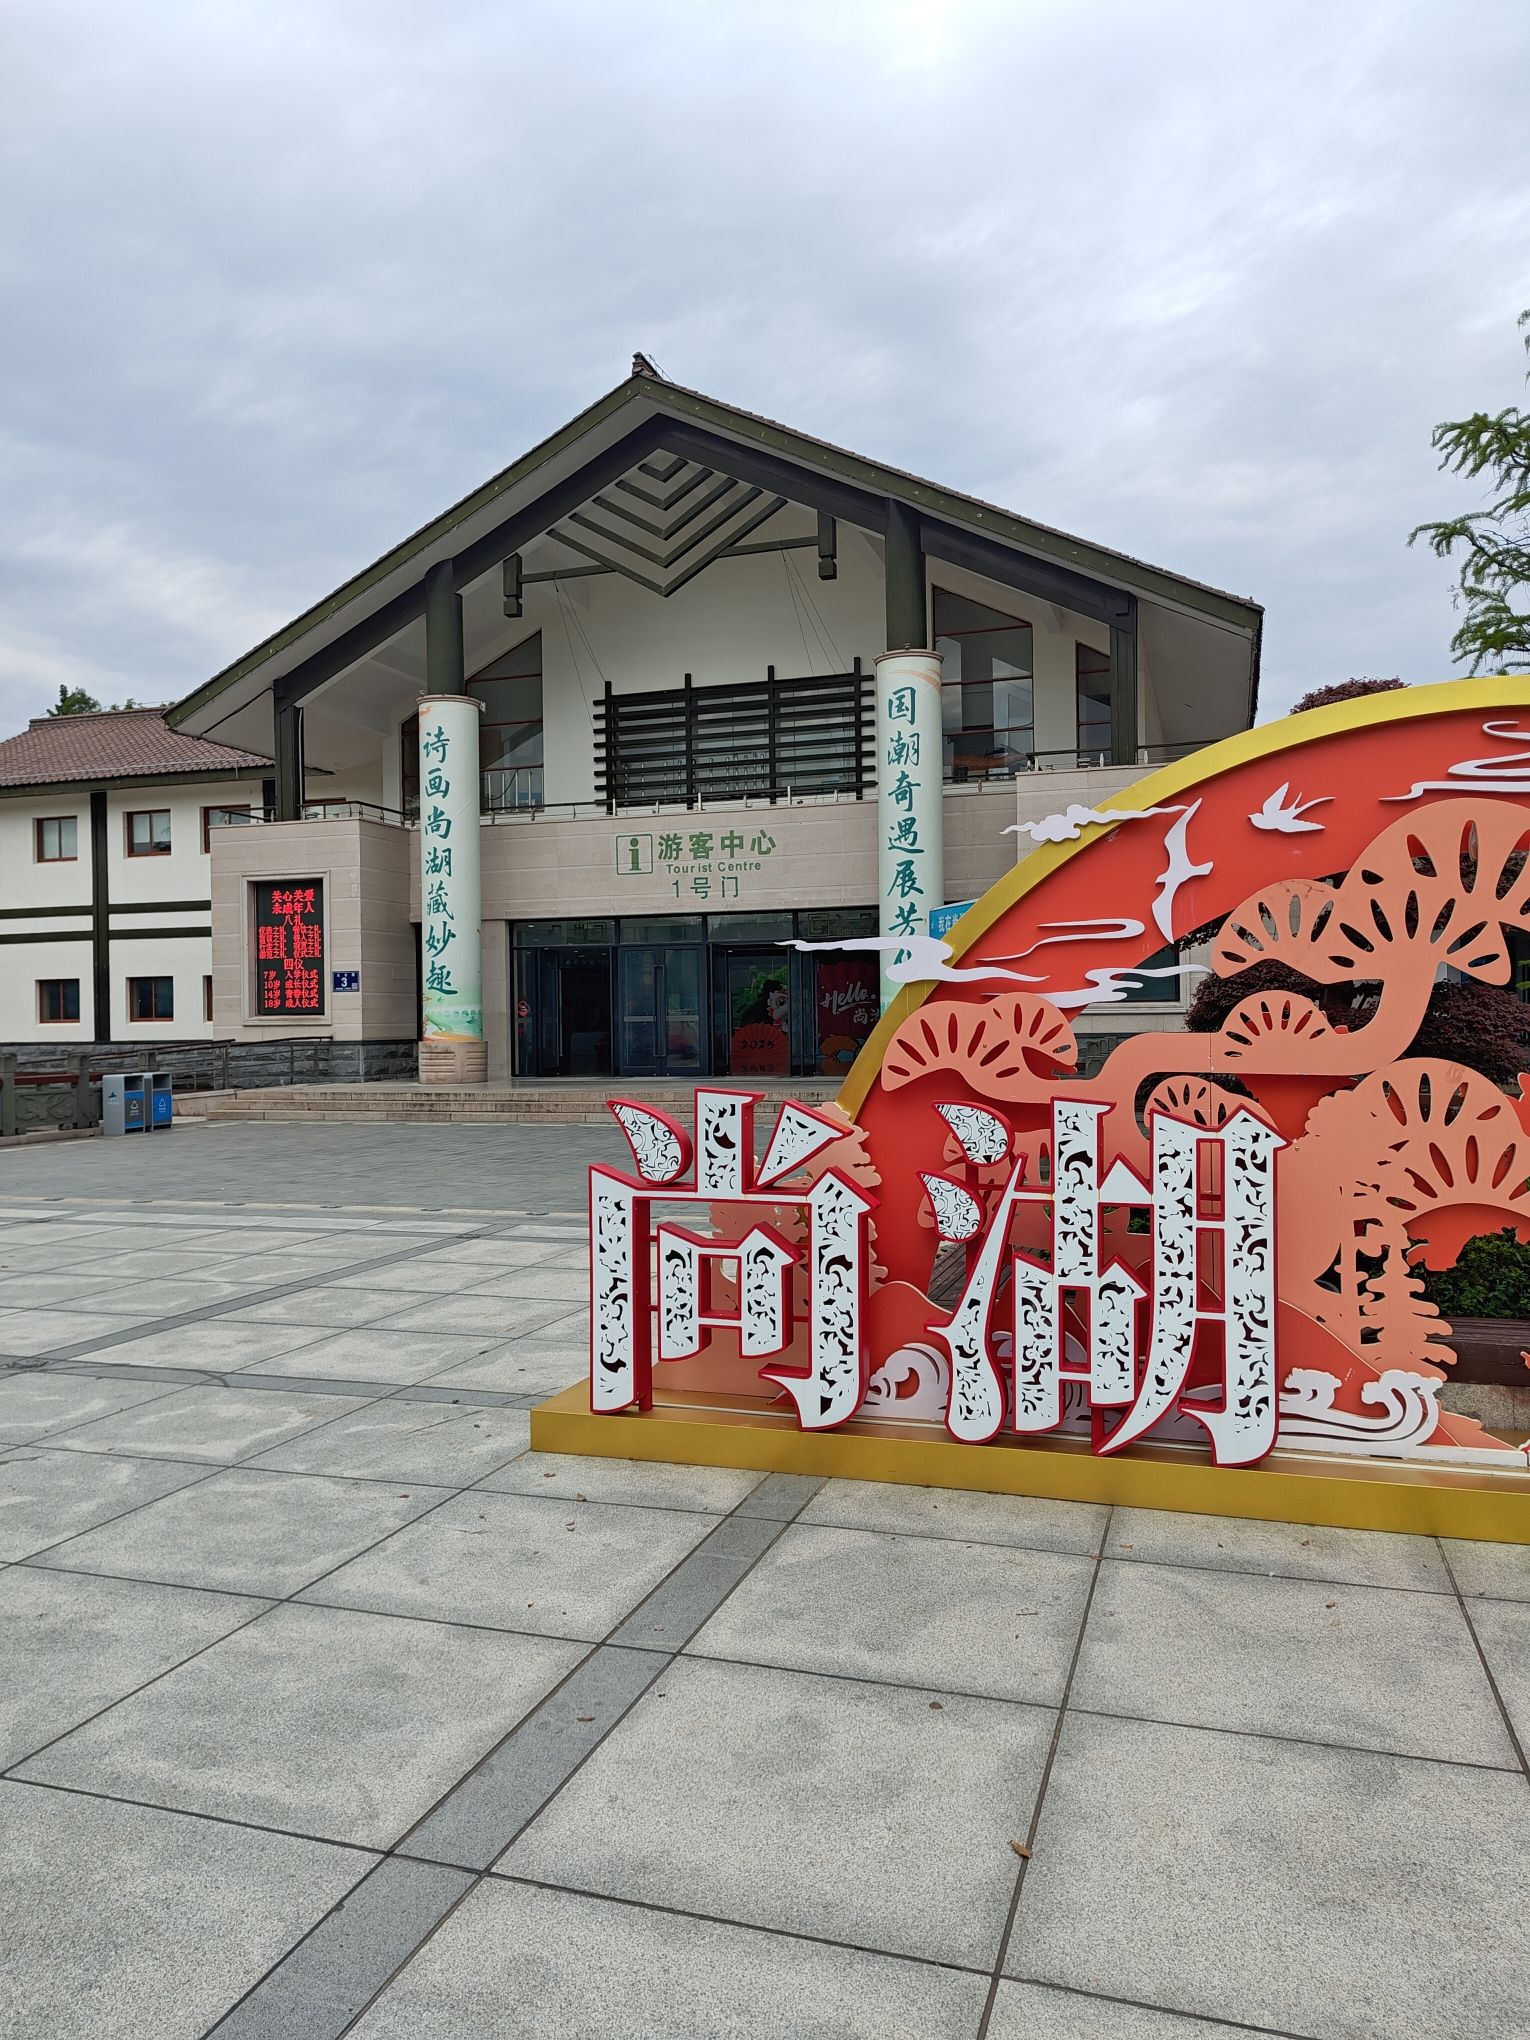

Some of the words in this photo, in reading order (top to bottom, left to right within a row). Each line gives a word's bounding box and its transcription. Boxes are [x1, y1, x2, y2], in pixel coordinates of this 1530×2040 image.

[887, 686, 925, 965] 国潮奇遇展芳
[657, 829, 777, 860] 游客中心
[423, 725, 458, 995] 诗画尚湖藏妙趣
[666, 863, 712, 874] Tourist
[717, 861, 762, 872] Centre
[671, 875, 739, 899] 1号门
[272, 889, 315, 902] 关心关爱
[272, 902, 315, 914] 未成年人
[284, 914, 303, 925] 八礼
[283, 959, 304, 970] 四仪
[263, 971, 276, 980] 7岁
[285, 969, 318, 979] 入学仪式
[264, 980, 281, 990] 10岁
[285, 979, 318, 989] 成长仪式
[341, 977, 348, 987] 3
[264, 989, 281, 999] 14岁
[264, 999, 281, 1008] 18岁
[285, 998, 319, 1008] 成人仪式
[741, 1040, 775, 1049] 2025
[589, 1087, 1294, 1469] 尚湖
